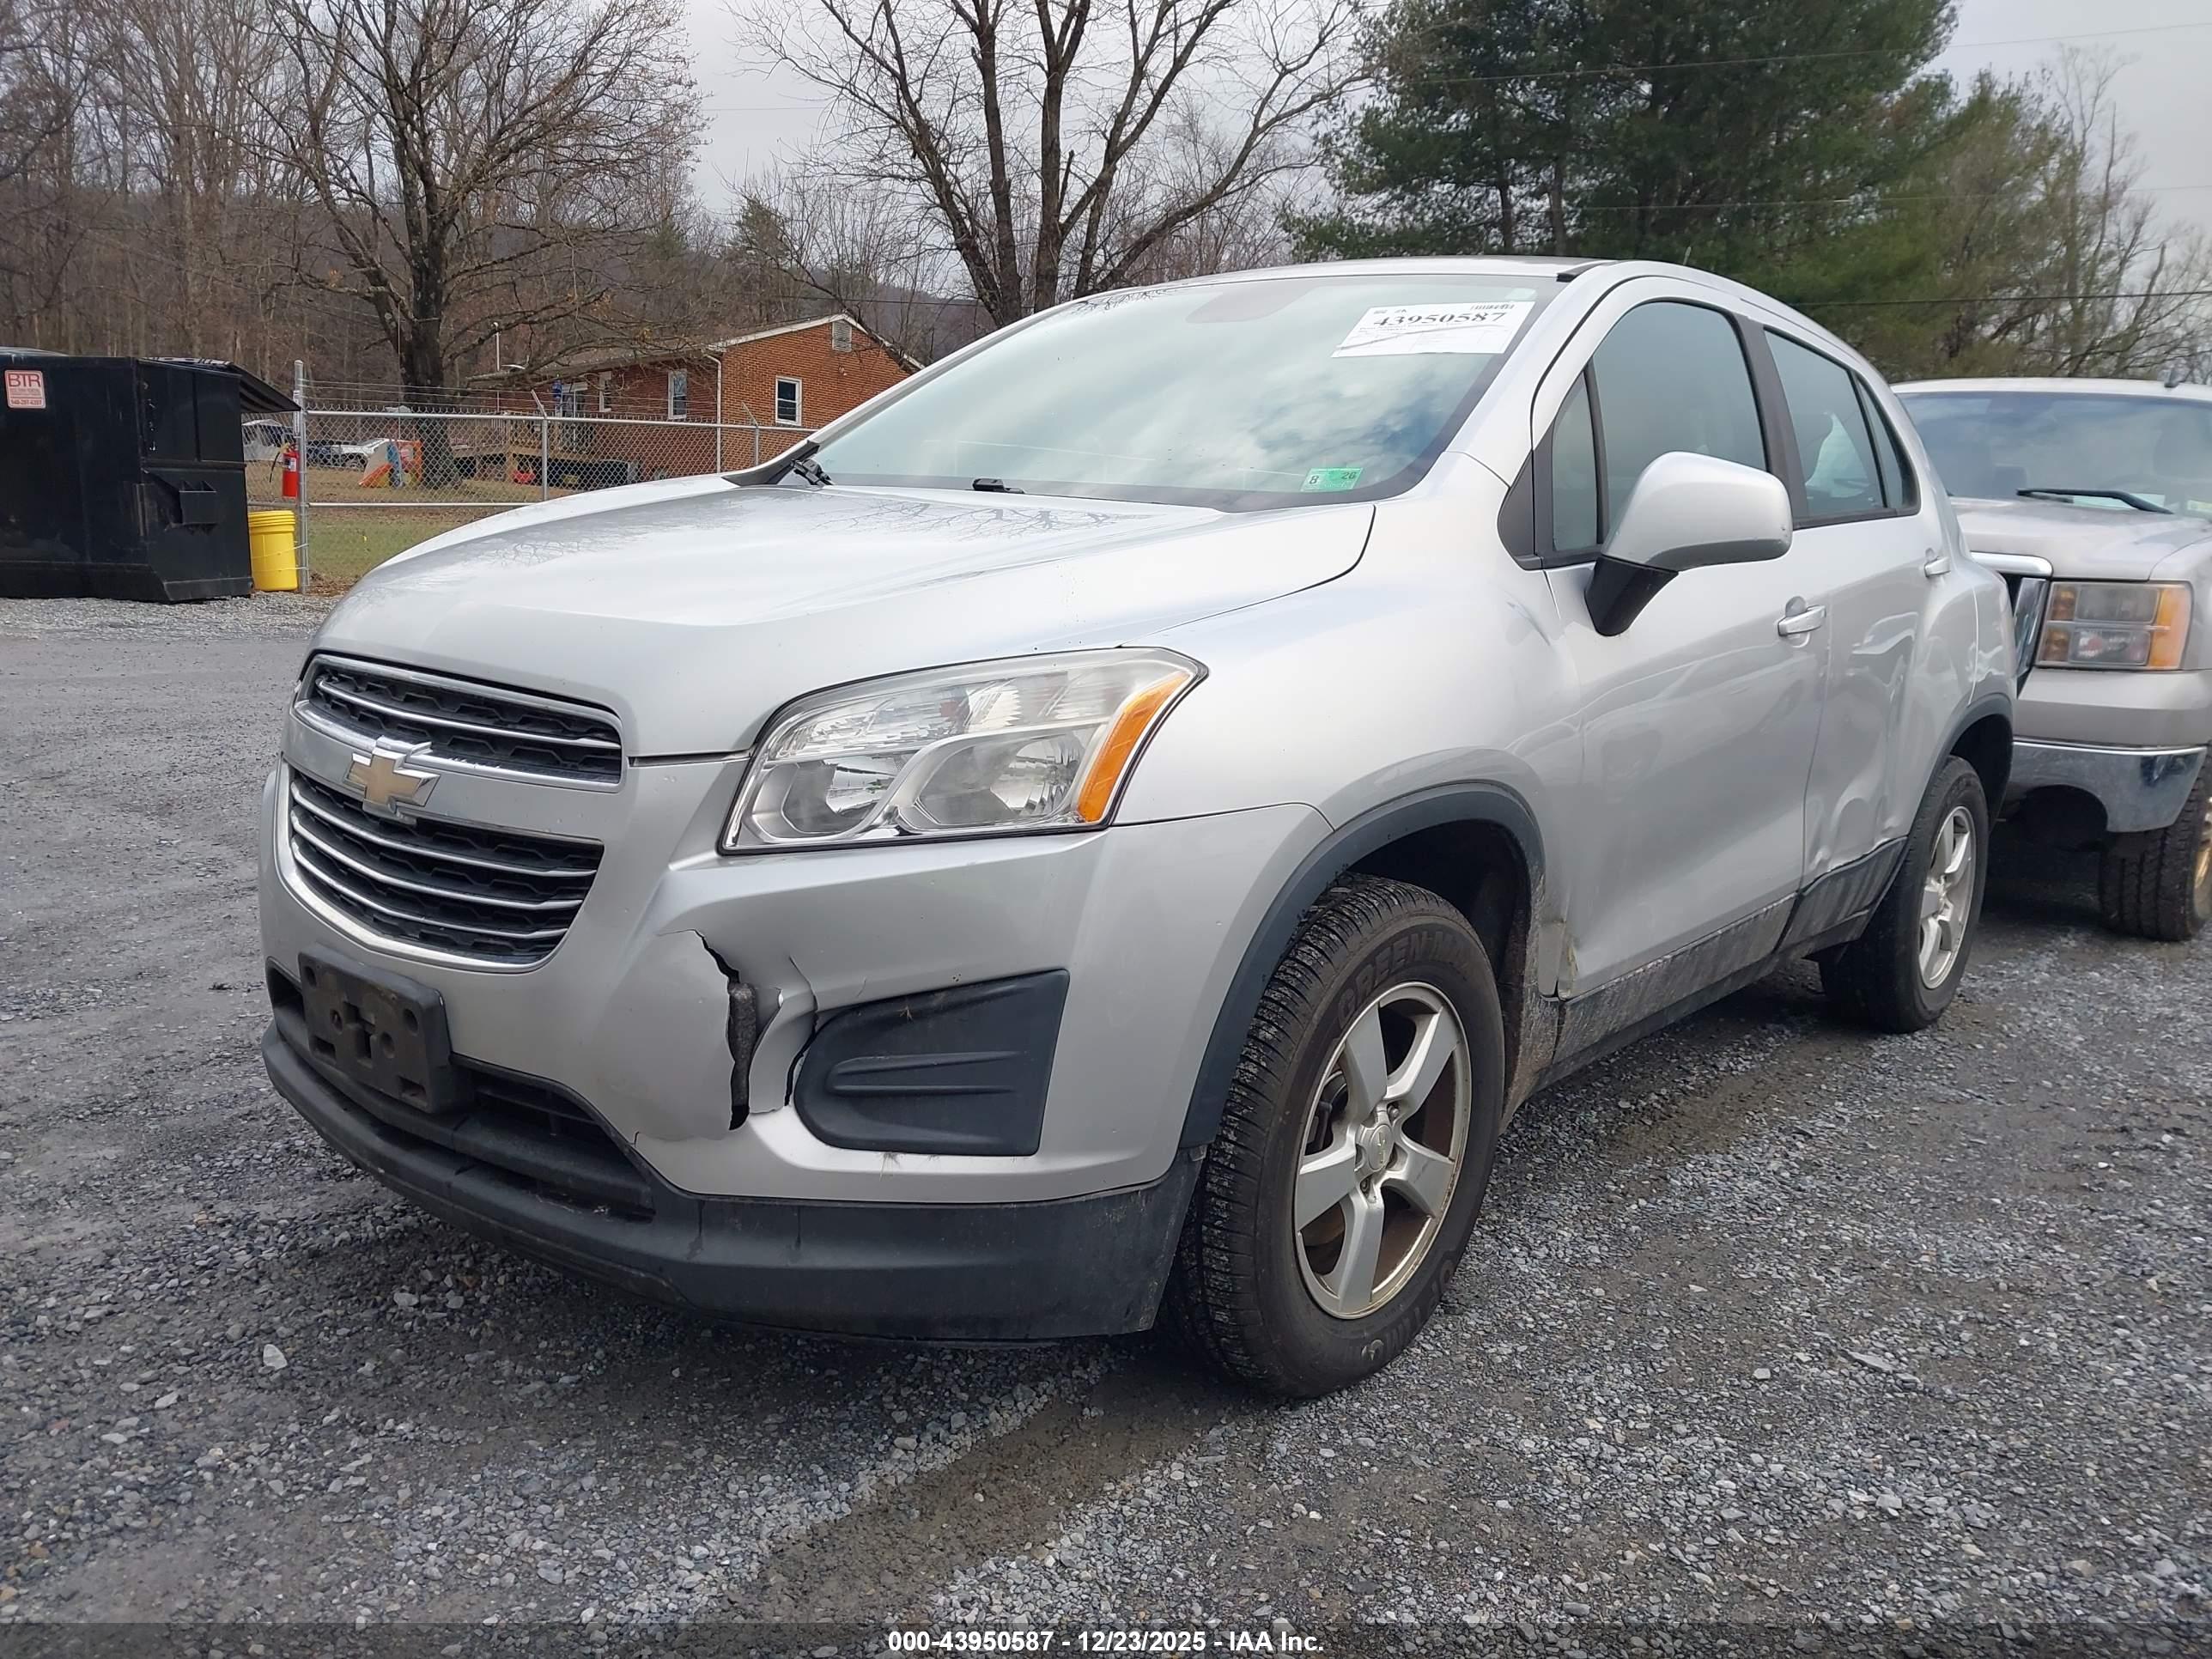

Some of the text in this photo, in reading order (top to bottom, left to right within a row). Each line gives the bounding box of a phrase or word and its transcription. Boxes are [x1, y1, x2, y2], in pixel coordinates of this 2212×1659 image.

[1373, 312, 1507, 326] 43950587
[8, 373, 41, 387] BTR
[1309, 475, 1320, 485] 8
